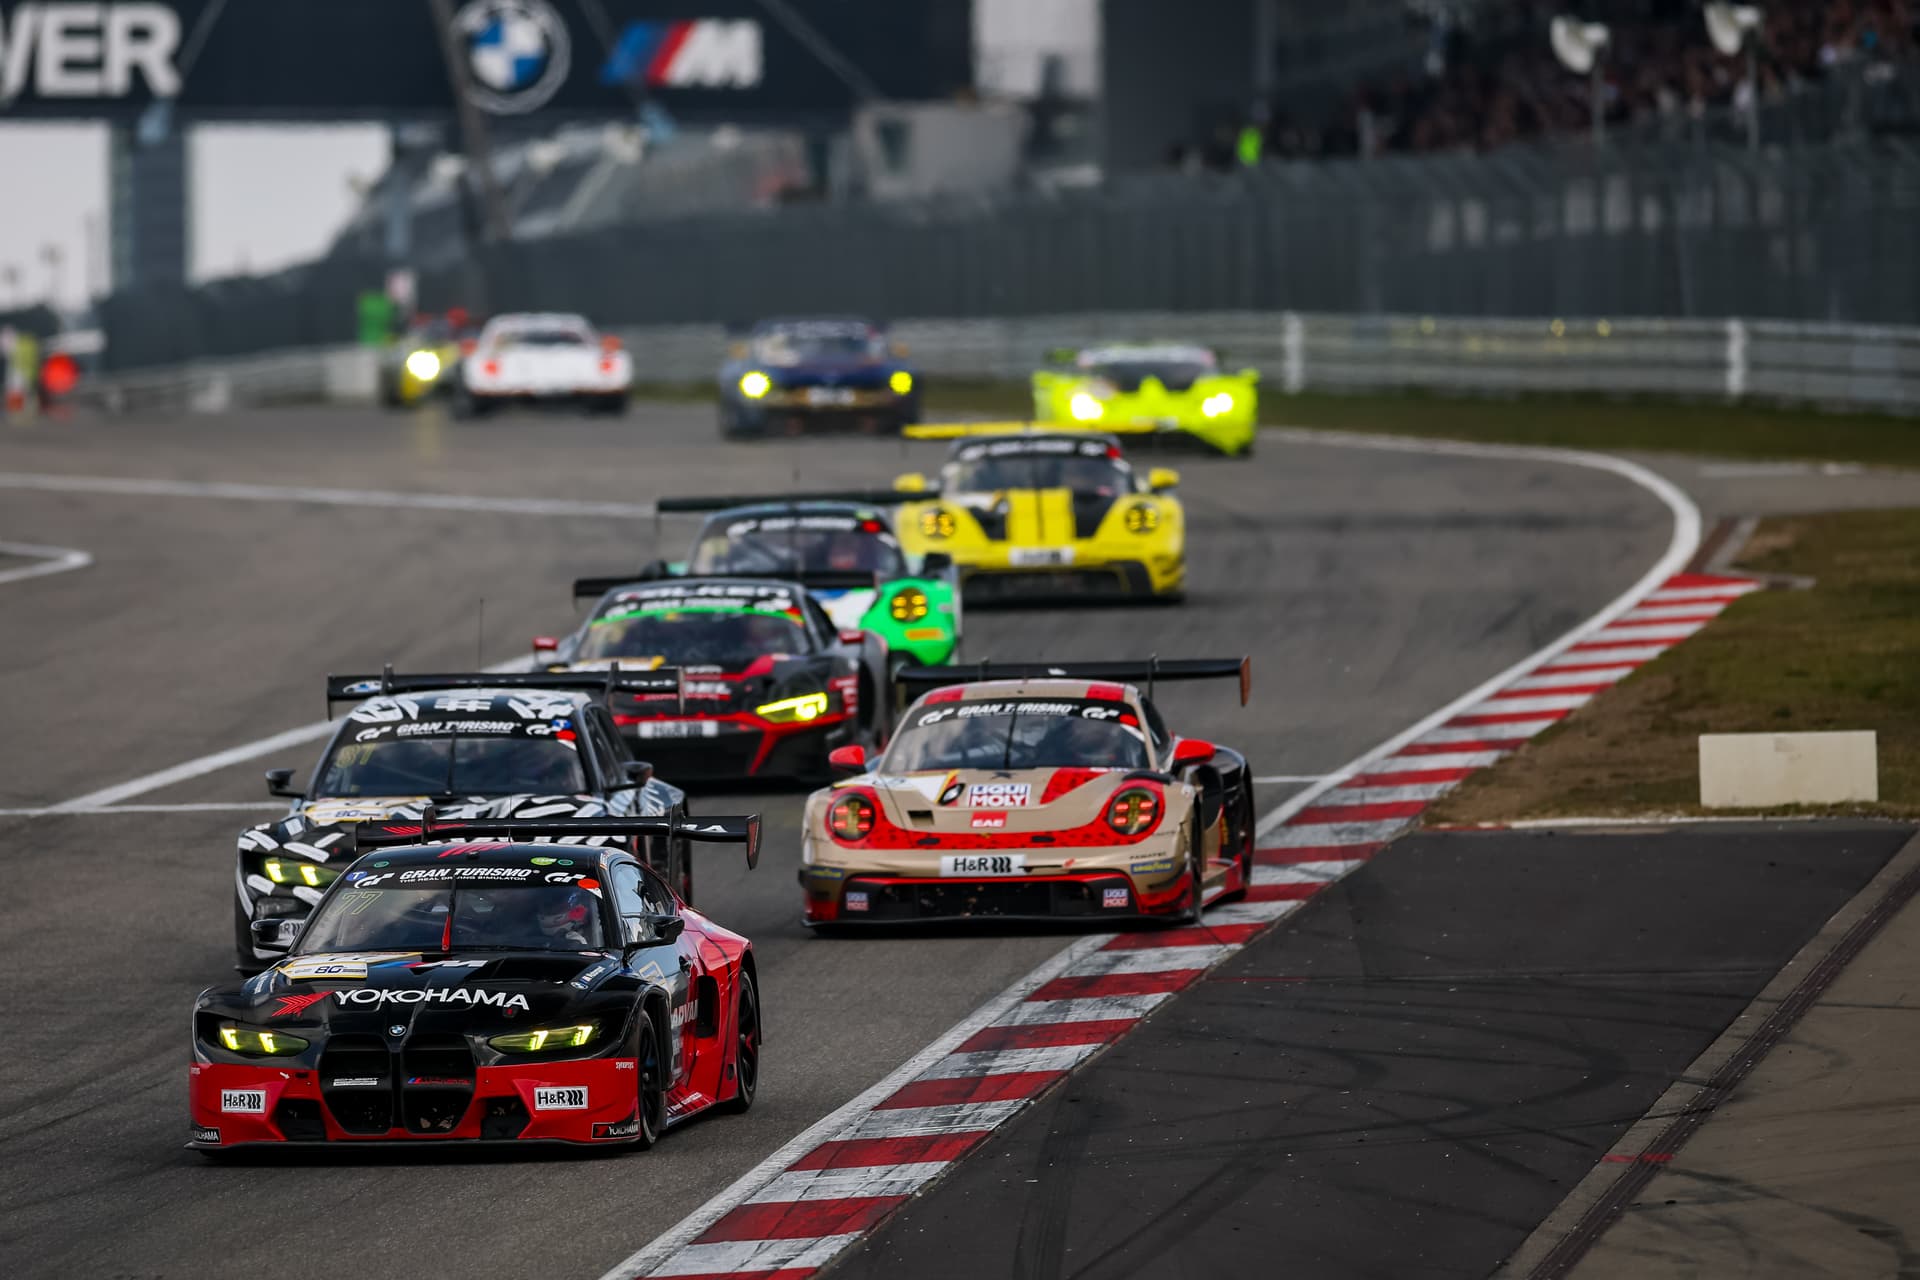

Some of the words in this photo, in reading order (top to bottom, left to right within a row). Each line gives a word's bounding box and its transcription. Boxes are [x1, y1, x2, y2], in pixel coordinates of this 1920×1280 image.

[958, 704, 1001, 717] GRAN
[397, 721, 442, 734] GRAN
[971, 794, 1027, 806] MOLY
[953, 857, 988, 872] H&R
[399, 868, 451, 880] GRAN
[455, 867, 532, 878] TURISMO
[336, 890, 384, 915] 77
[334, 987, 530, 1010] YOKOHAMA
[223, 1093, 246, 1107] H&R
[537, 1091, 567, 1105] H&R
